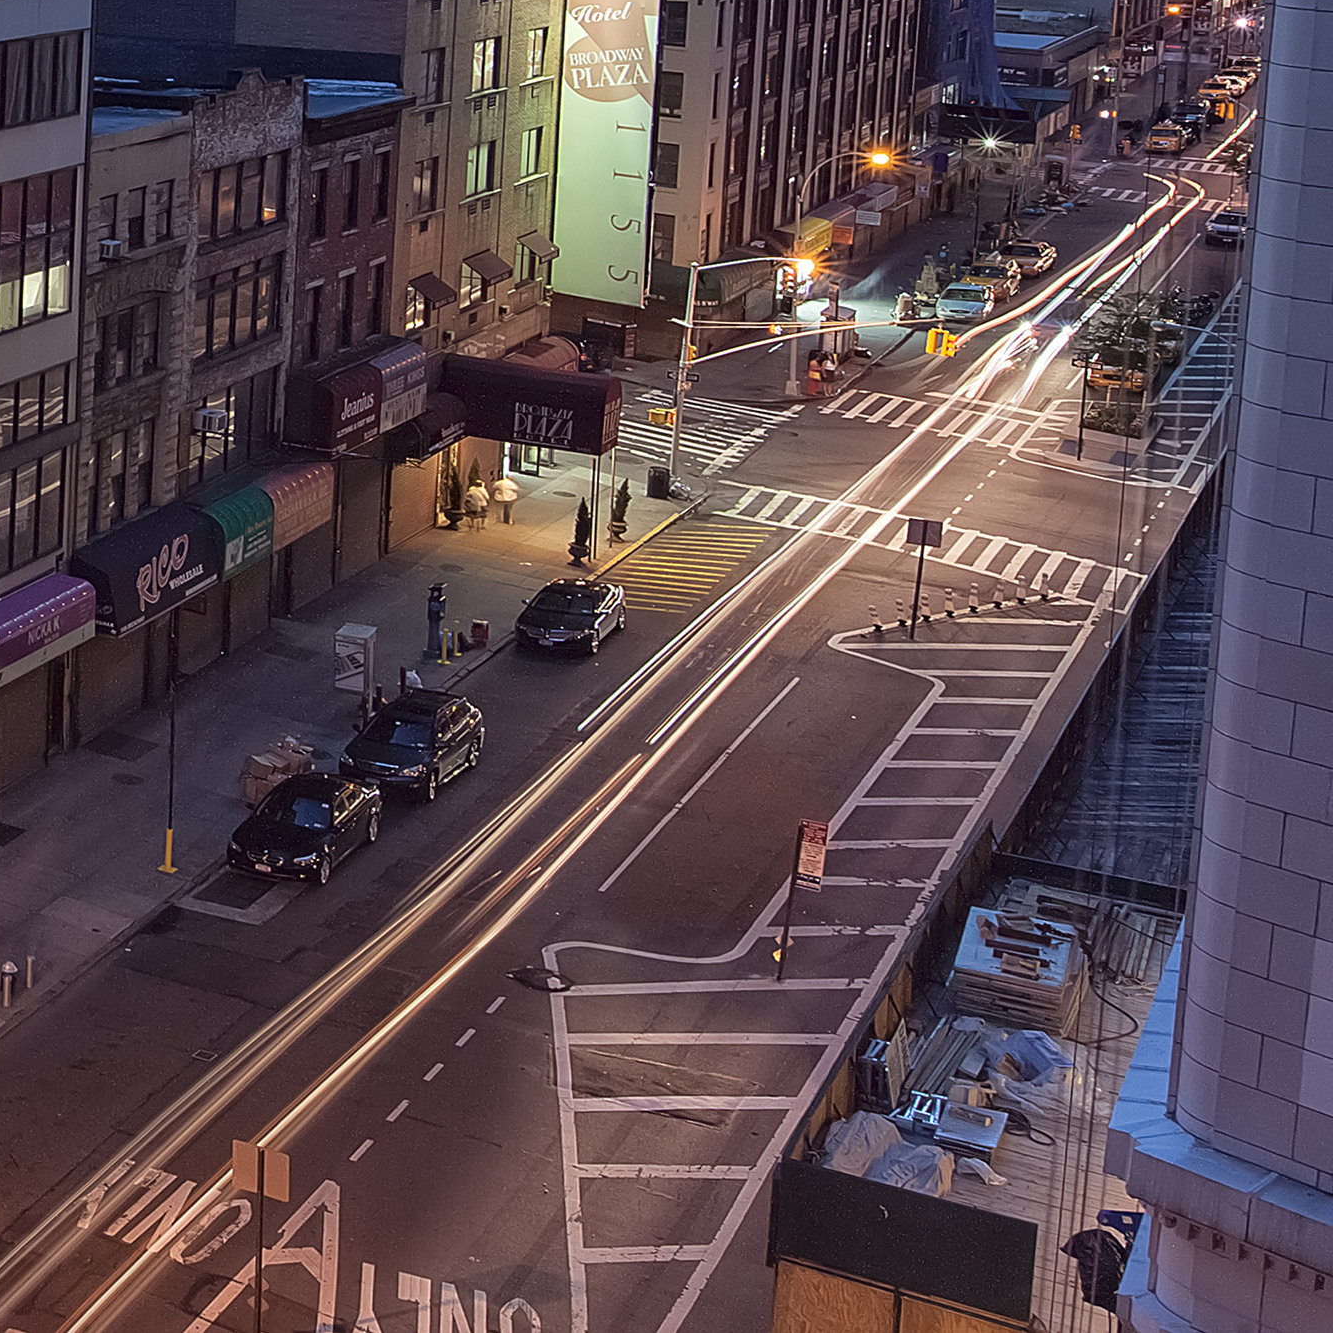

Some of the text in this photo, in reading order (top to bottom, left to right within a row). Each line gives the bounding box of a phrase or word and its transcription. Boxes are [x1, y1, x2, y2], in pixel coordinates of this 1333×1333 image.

[571, 1, 632, 24] Hotel
[569, 47, 645, 66] BROADWAY
[571, 63, 651, 90] PLAZA
[513, 413, 573, 440] PLAZA
[136, 533, 189, 612] RICO
[168, 563, 204, 590] WHOLESALE
